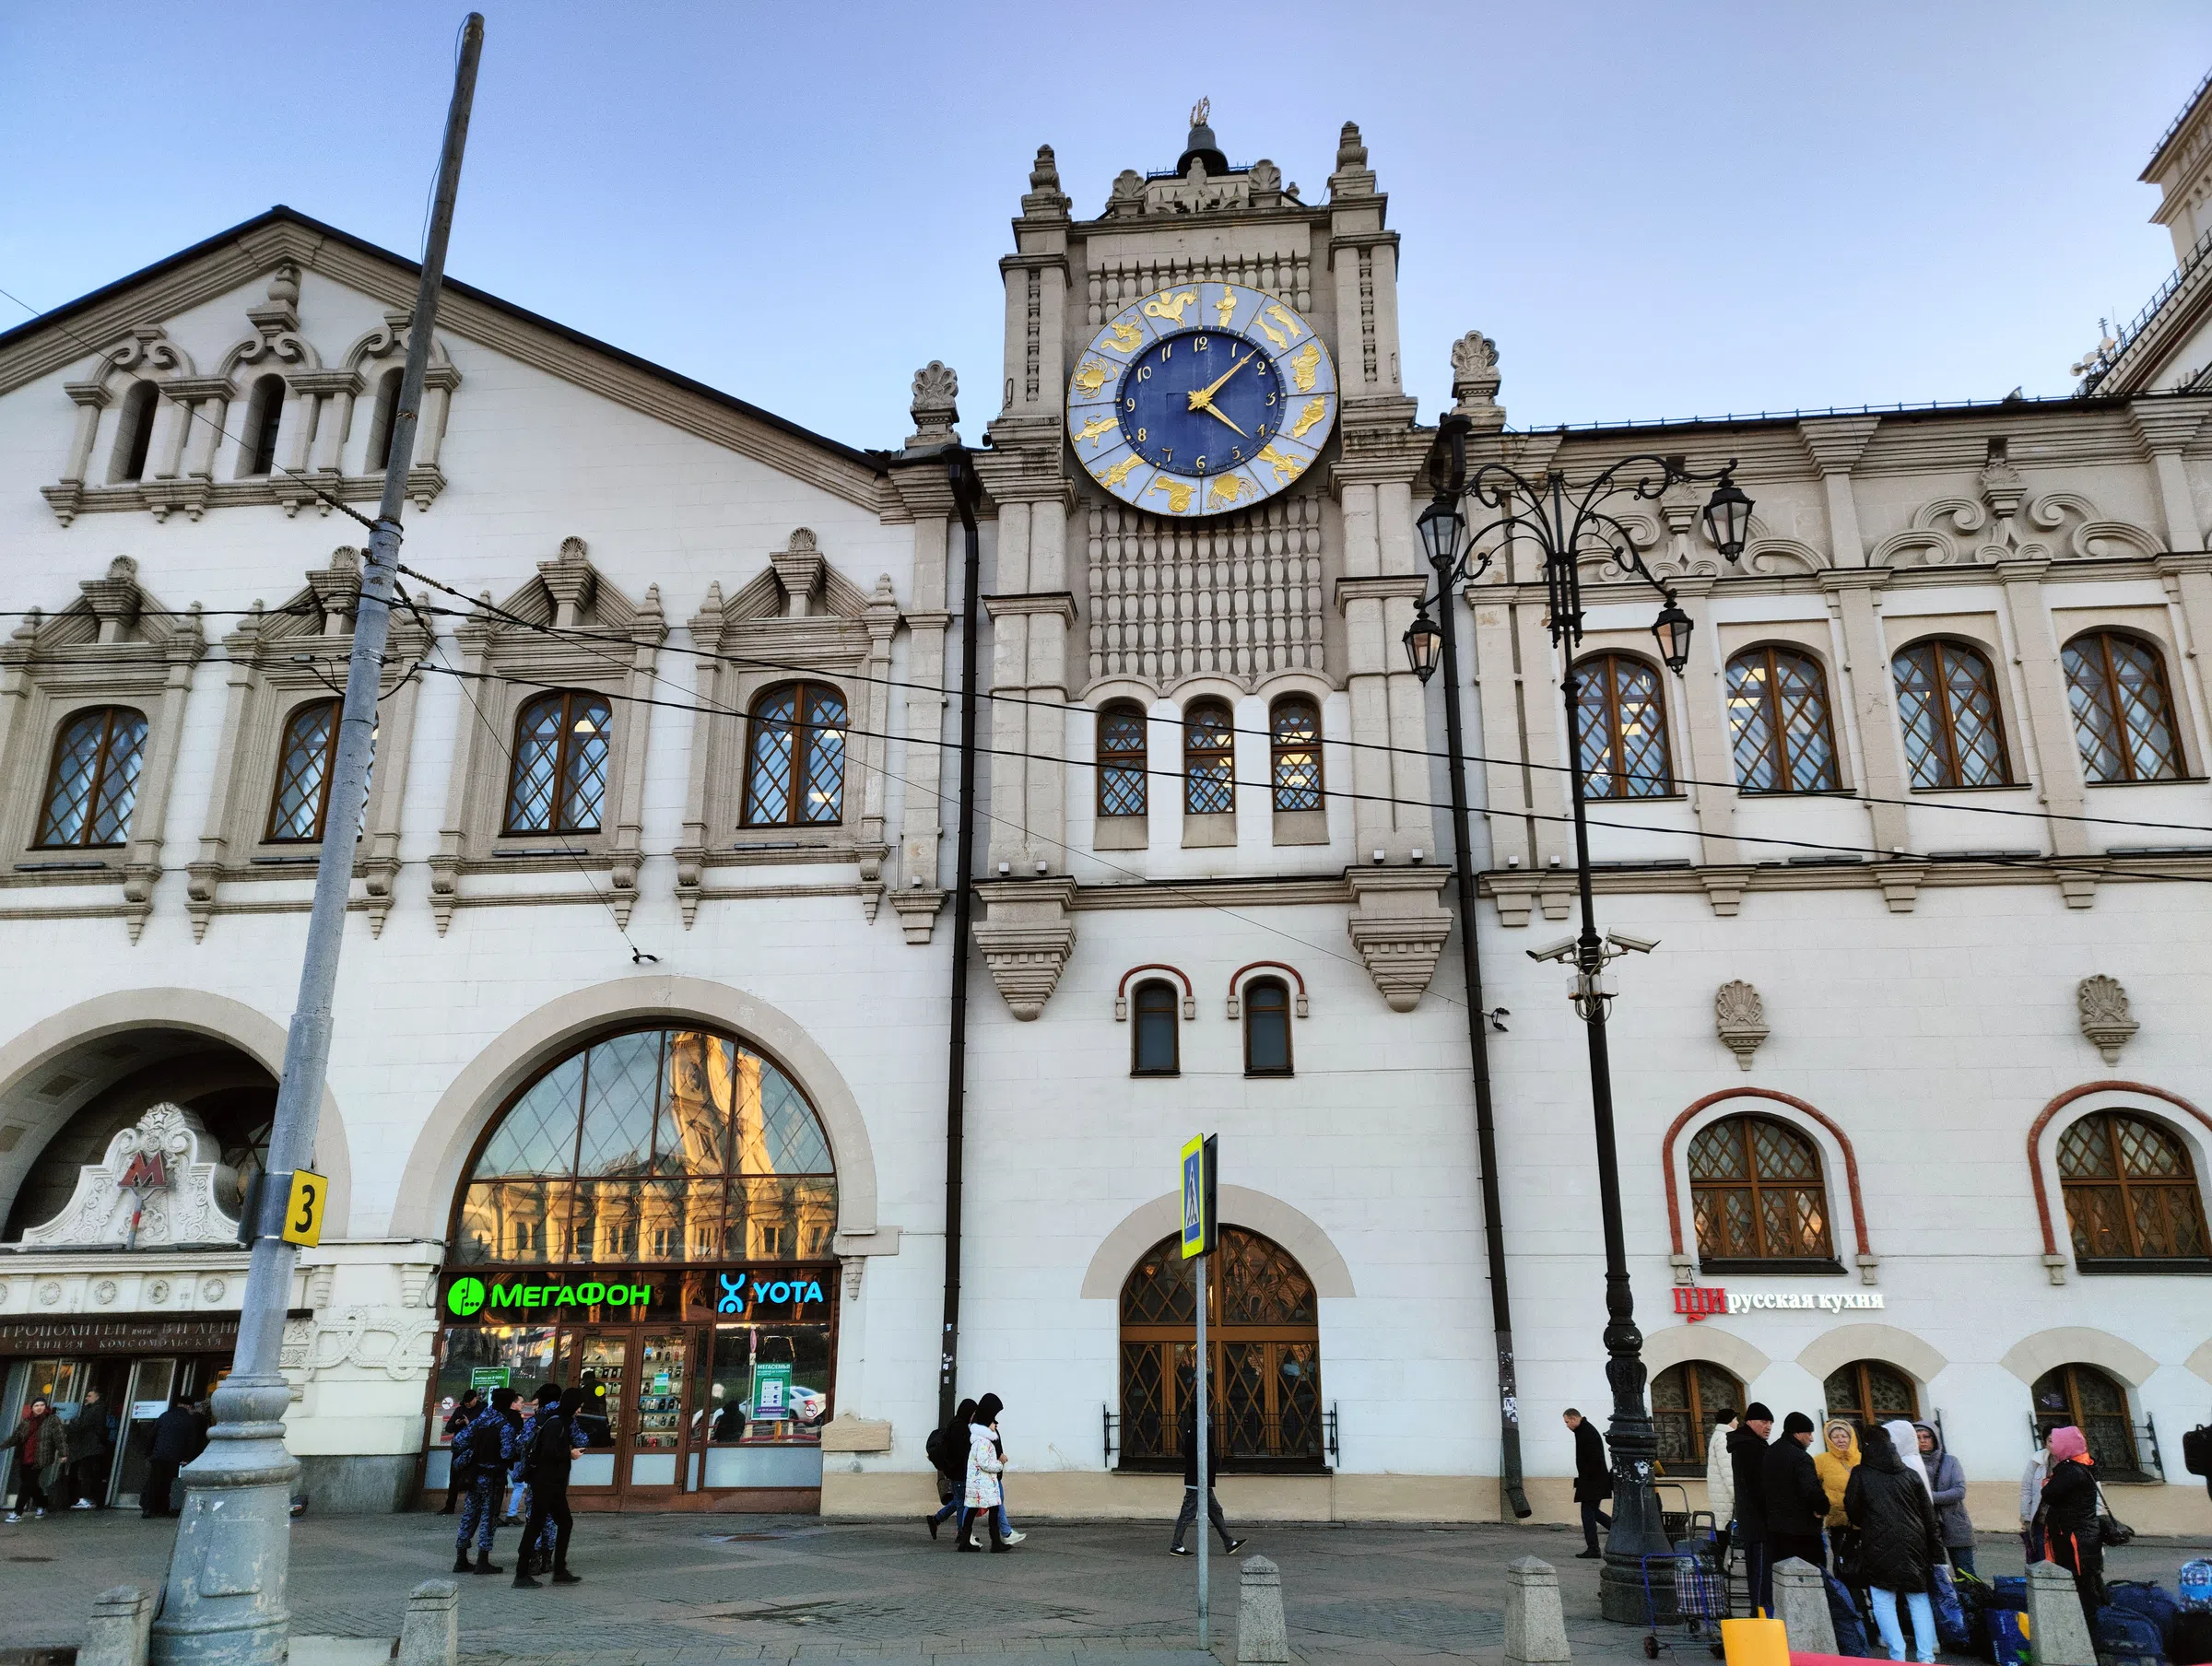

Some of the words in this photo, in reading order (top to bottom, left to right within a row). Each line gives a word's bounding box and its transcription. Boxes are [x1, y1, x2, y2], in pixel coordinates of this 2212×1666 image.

[1194, 336, 1208, 352] 12
[1230, 342, 1237, 358] 1
[1161, 343, 1172, 363] 11
[1137, 365, 1152, 383] 10
[1256, 360, 1266, 376] 2
[1126, 397, 1135, 413] 9
[1265, 392, 1277, 406] 3
[1137, 428, 1147, 442] 8
[1161, 447, 1173, 463] 7
[1231, 445, 1241, 460] 5
[1195, 454, 1206, 469] 6
[294, 1184, 315, 1233] 3
[753, 1281, 824, 1304] YOTA
[1672, 1287, 1729, 1323] ЩИ
[1726, 1293, 1815, 1314] русская
[1817, 1293, 1885, 1314] кухня
